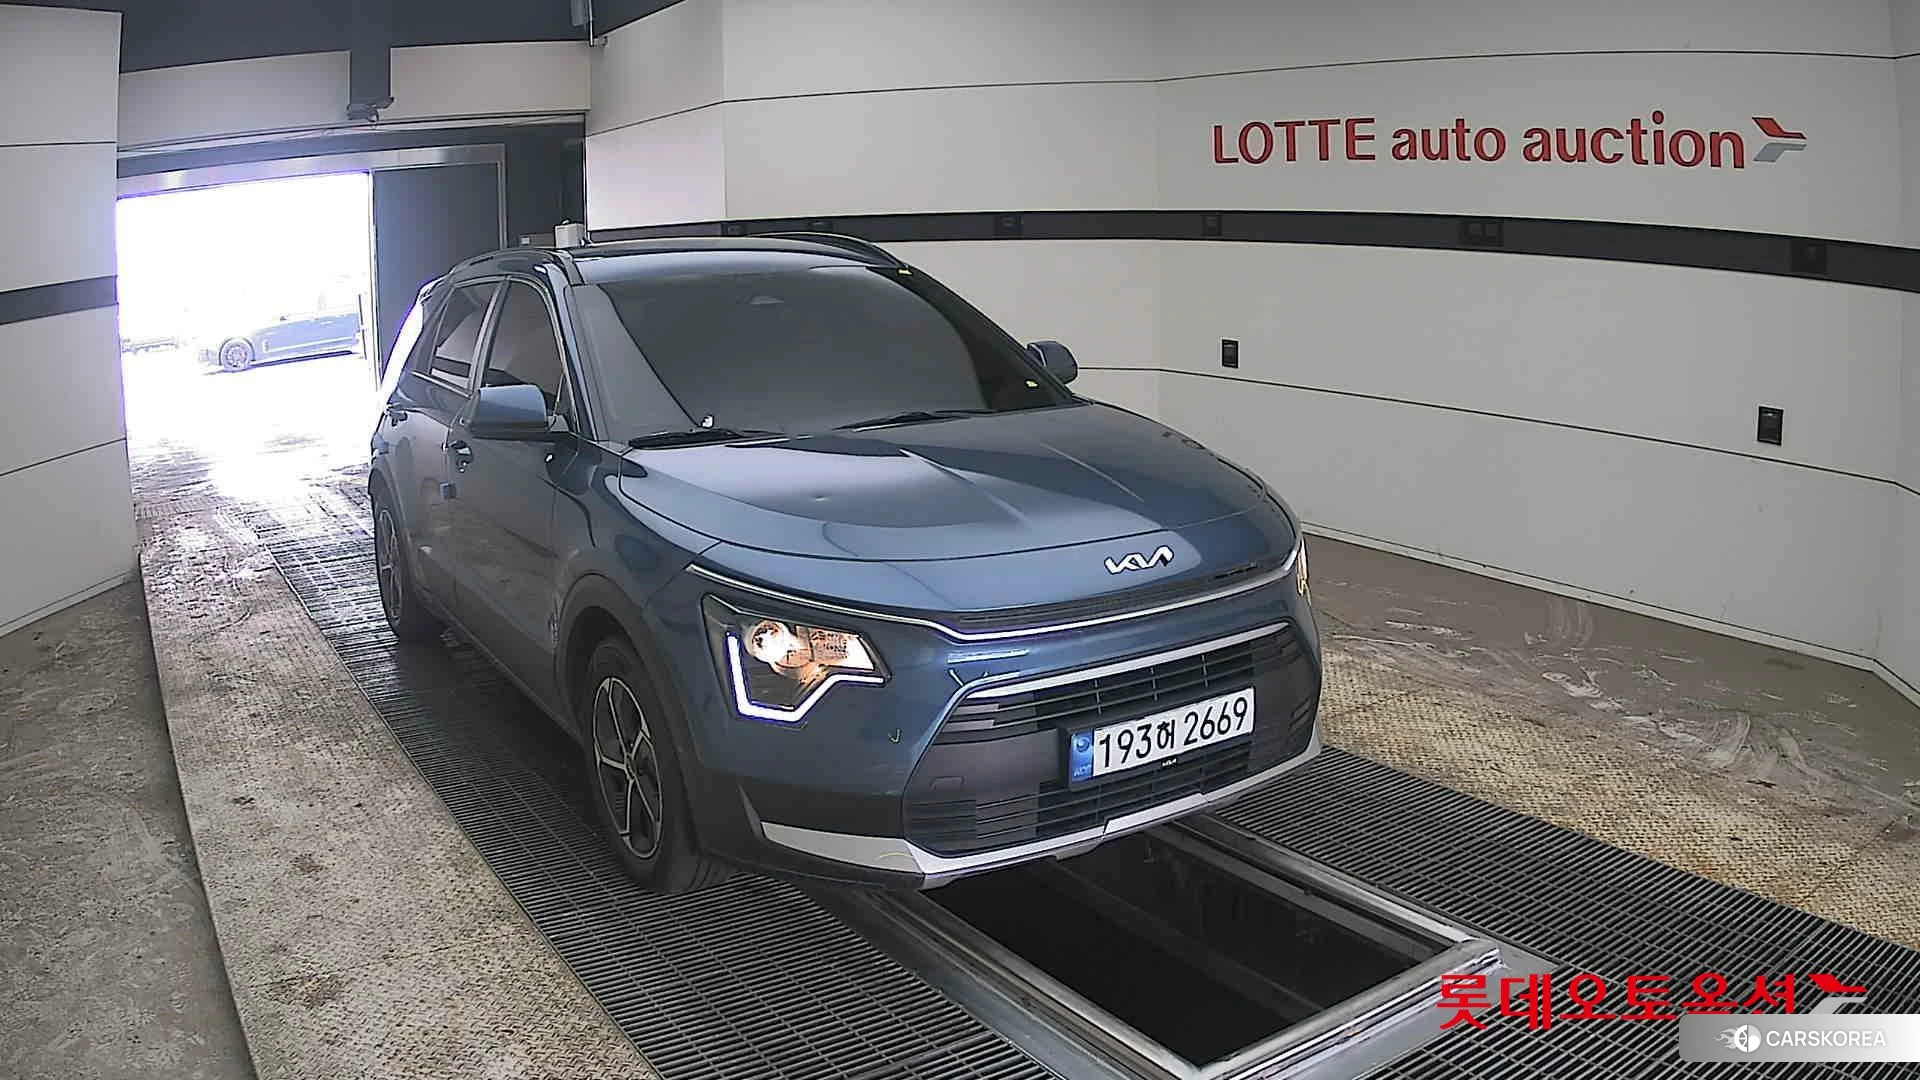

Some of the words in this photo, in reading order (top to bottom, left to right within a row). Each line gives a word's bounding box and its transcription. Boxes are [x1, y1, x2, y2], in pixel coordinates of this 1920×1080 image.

[1212, 117, 1377, 165] LOTTE
[1391, 118, 1507, 162] auto
[1522, 110, 1746, 169] auction
[1099, 719, 1176, 769] 193허
[1183, 696, 1248, 747] 2669
